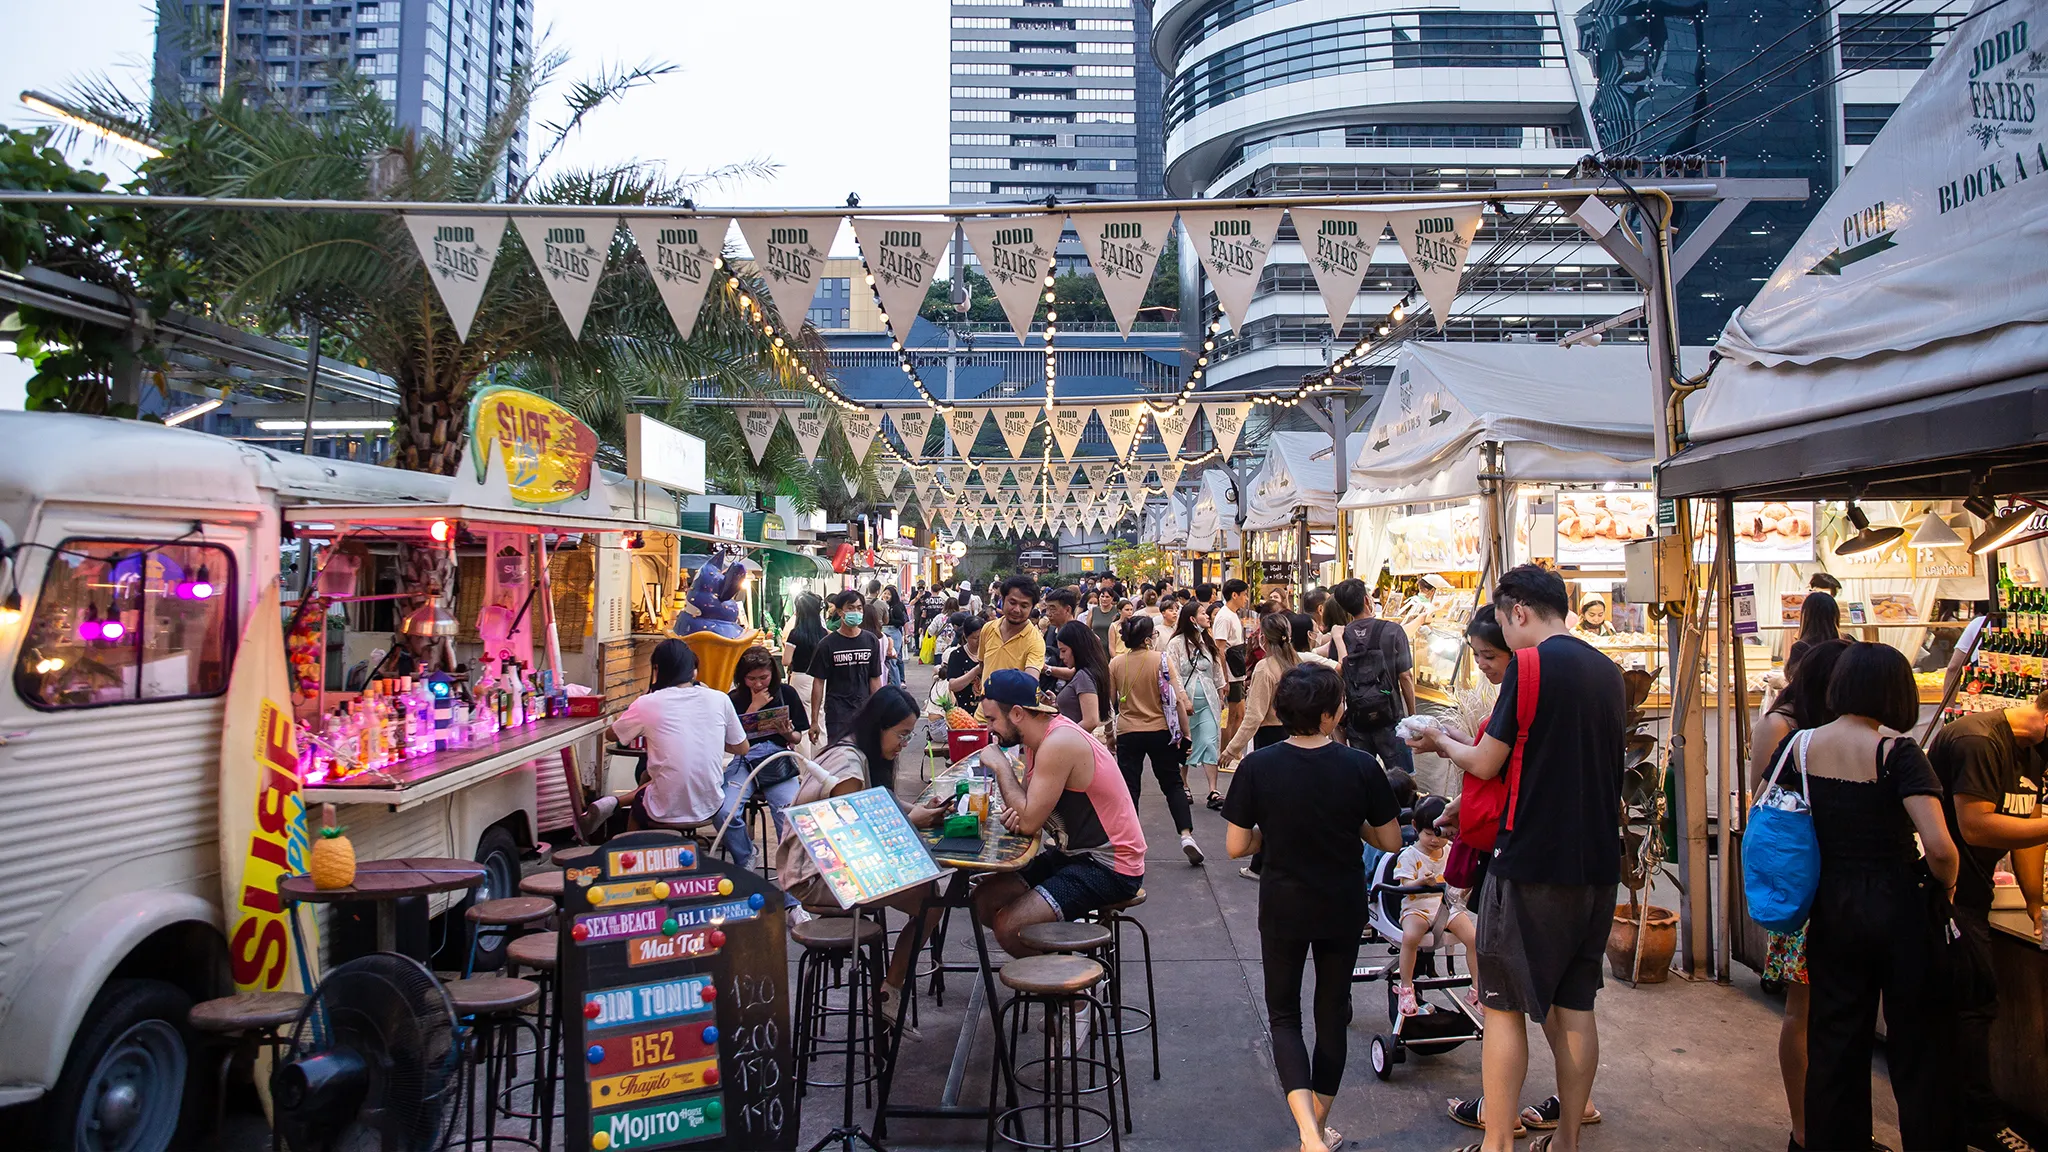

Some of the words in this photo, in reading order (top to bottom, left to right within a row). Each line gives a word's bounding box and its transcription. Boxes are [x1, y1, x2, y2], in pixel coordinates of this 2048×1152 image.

[1968, 20, 2029, 80] JODD
[1968, 80, 2036, 124] FAIRS
[1937, 160, 2007, 215] BLOCK
[2013, 152, 2028, 184] A
[433, 225, 474, 243] JODD
[544, 227, 585, 244] JODD
[656, 228, 698, 245] JODD
[767, 228, 808, 245] JODD
[880, 230, 921, 248] JODD
[992, 227, 1034, 246] JODD
[1100, 222, 1142, 239] JODD
[1209, 219, 1251, 236] JODD
[1317, 219, 1358, 236] JODD
[1415, 217, 1454, 235] JODD
[1843, 200, 1887, 247] even
[433, 241, 479, 278] FAIRS
[545, 243, 590, 278] FAIRS
[657, 243, 701, 280] FAIRS
[767, 243, 811, 280] FAIRS
[880, 245, 921, 284] FAIRS
[992, 244, 1037, 282] FAIRS
[1100, 238, 1143, 274] FAIRS
[1210, 235, 1254, 272] FAIRS
[1317, 235, 1361, 271] FAIRS
[1415, 234, 1457, 268] FAIRS
[496, 401, 551, 455] SURF
[2002, 792, 2037, 815] PUMA
[231, 706, 301, 990] SURF
[673, 879, 716, 894] WINE
[586, 916, 609, 938] SEX
[620, 911, 657, 933] BEACH
[640, 937, 674, 960] Mai
[676, 932, 705, 954] Tai
[631, 1030, 675, 1067] B52
